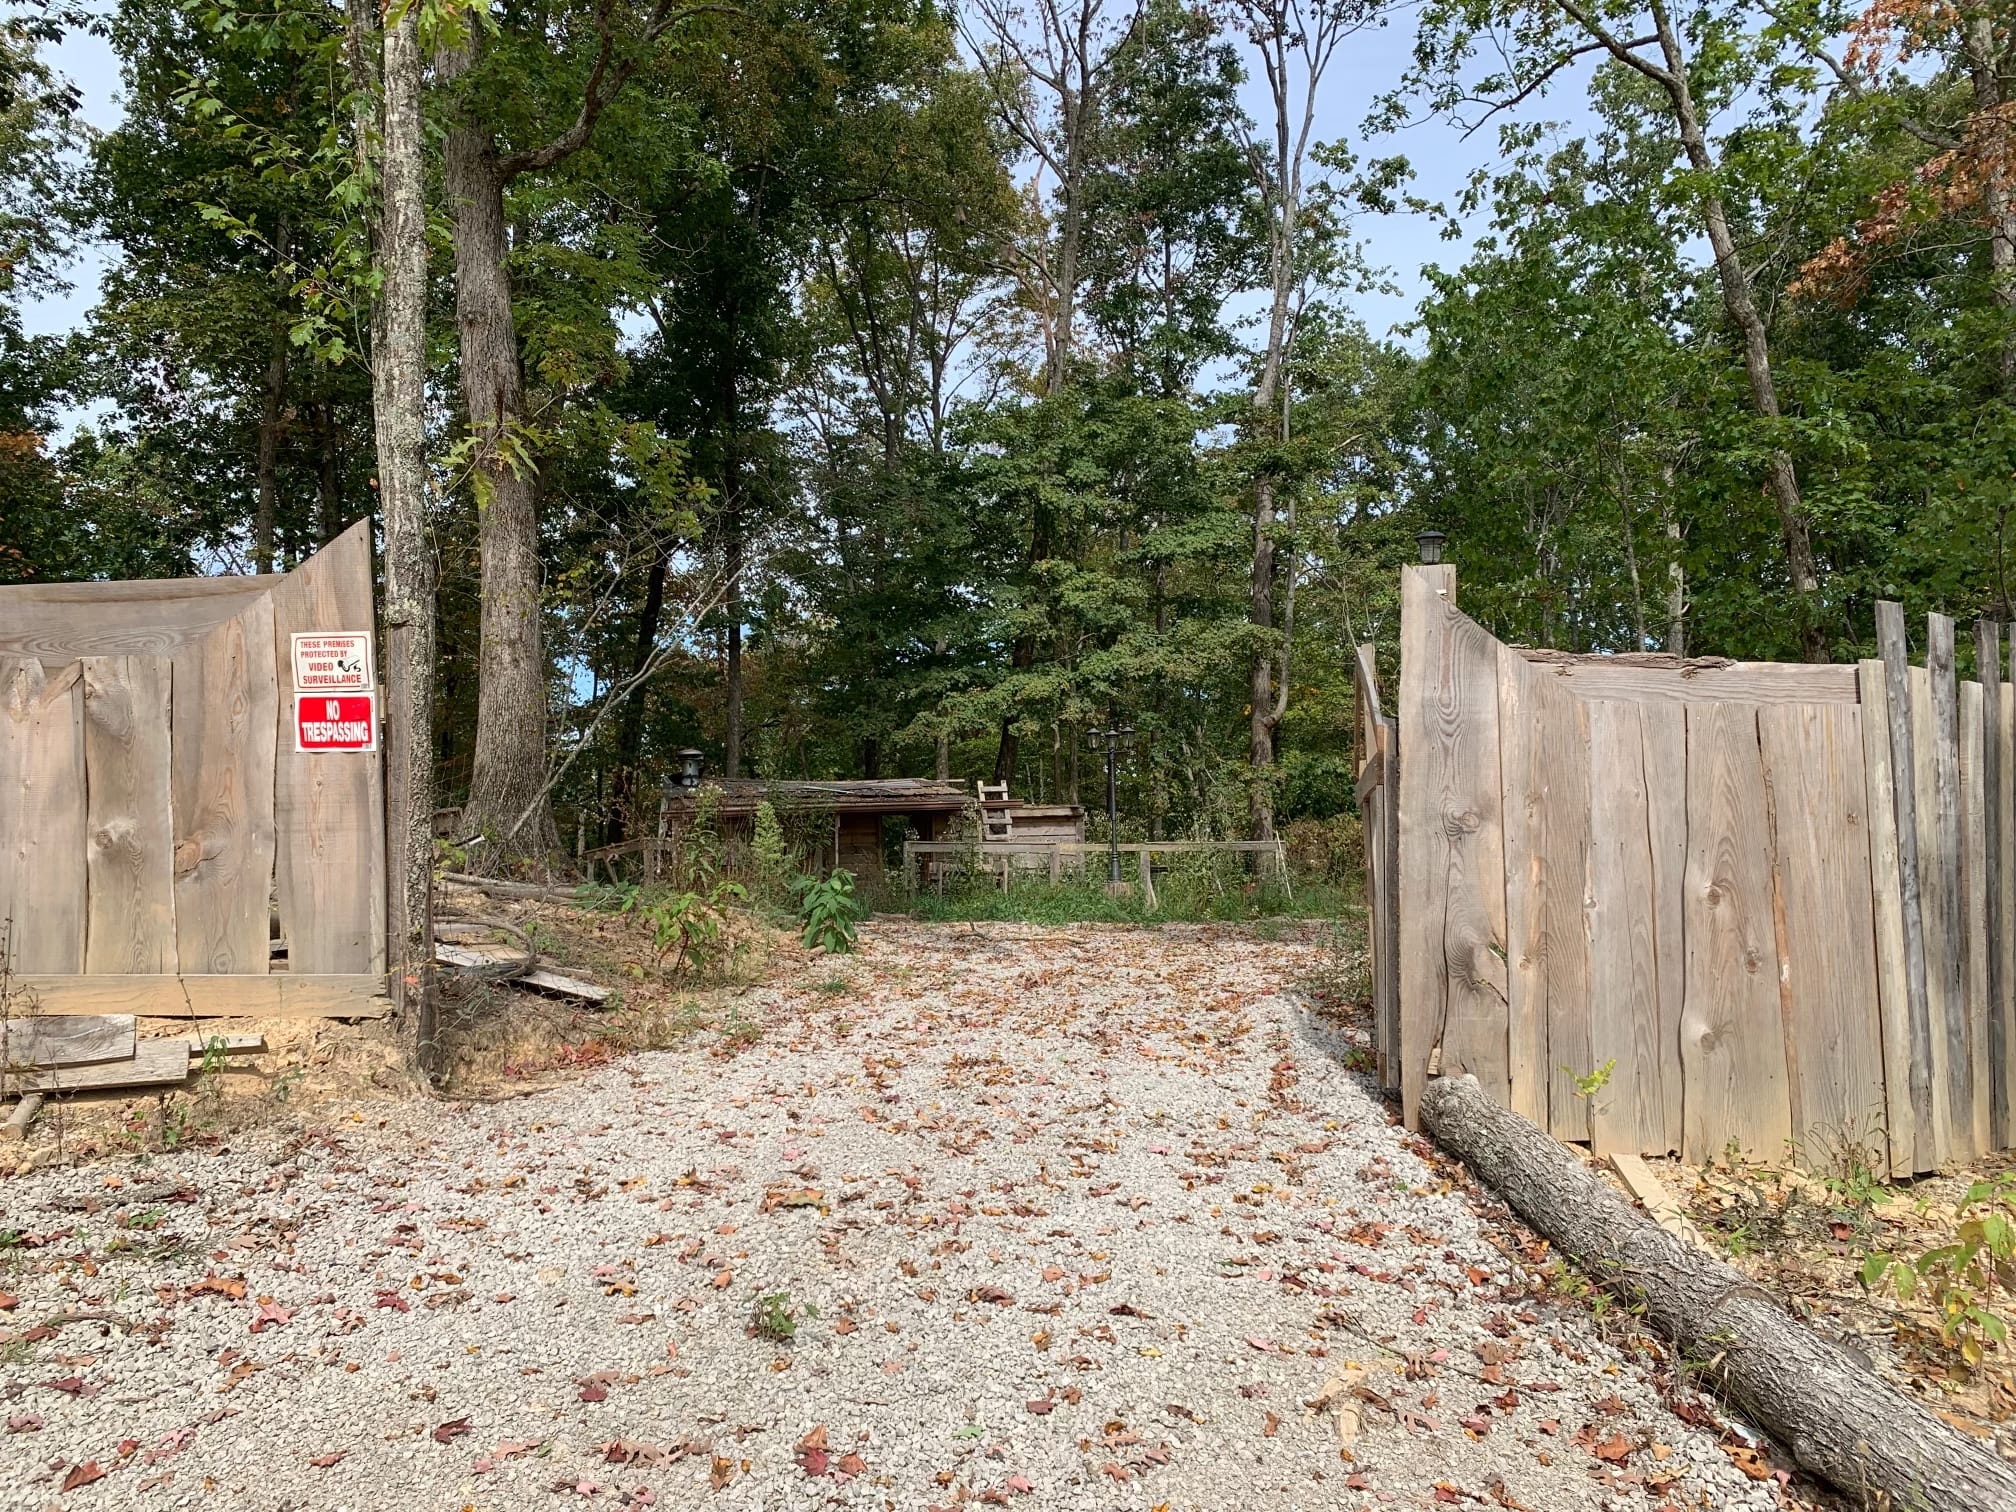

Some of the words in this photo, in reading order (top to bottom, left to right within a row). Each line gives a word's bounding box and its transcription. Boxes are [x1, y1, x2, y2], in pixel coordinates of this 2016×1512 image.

[300, 640, 321, 649] THESE
[323, 640, 355, 648] PREMISES
[300, 650, 339, 658] PROTECTED
[308, 662, 334, 672] VIDEO
[303, 674, 362, 684] SURVEILLANCE
[325, 700, 340, 720] NO
[301, 721, 369, 742] TRESPASSING
